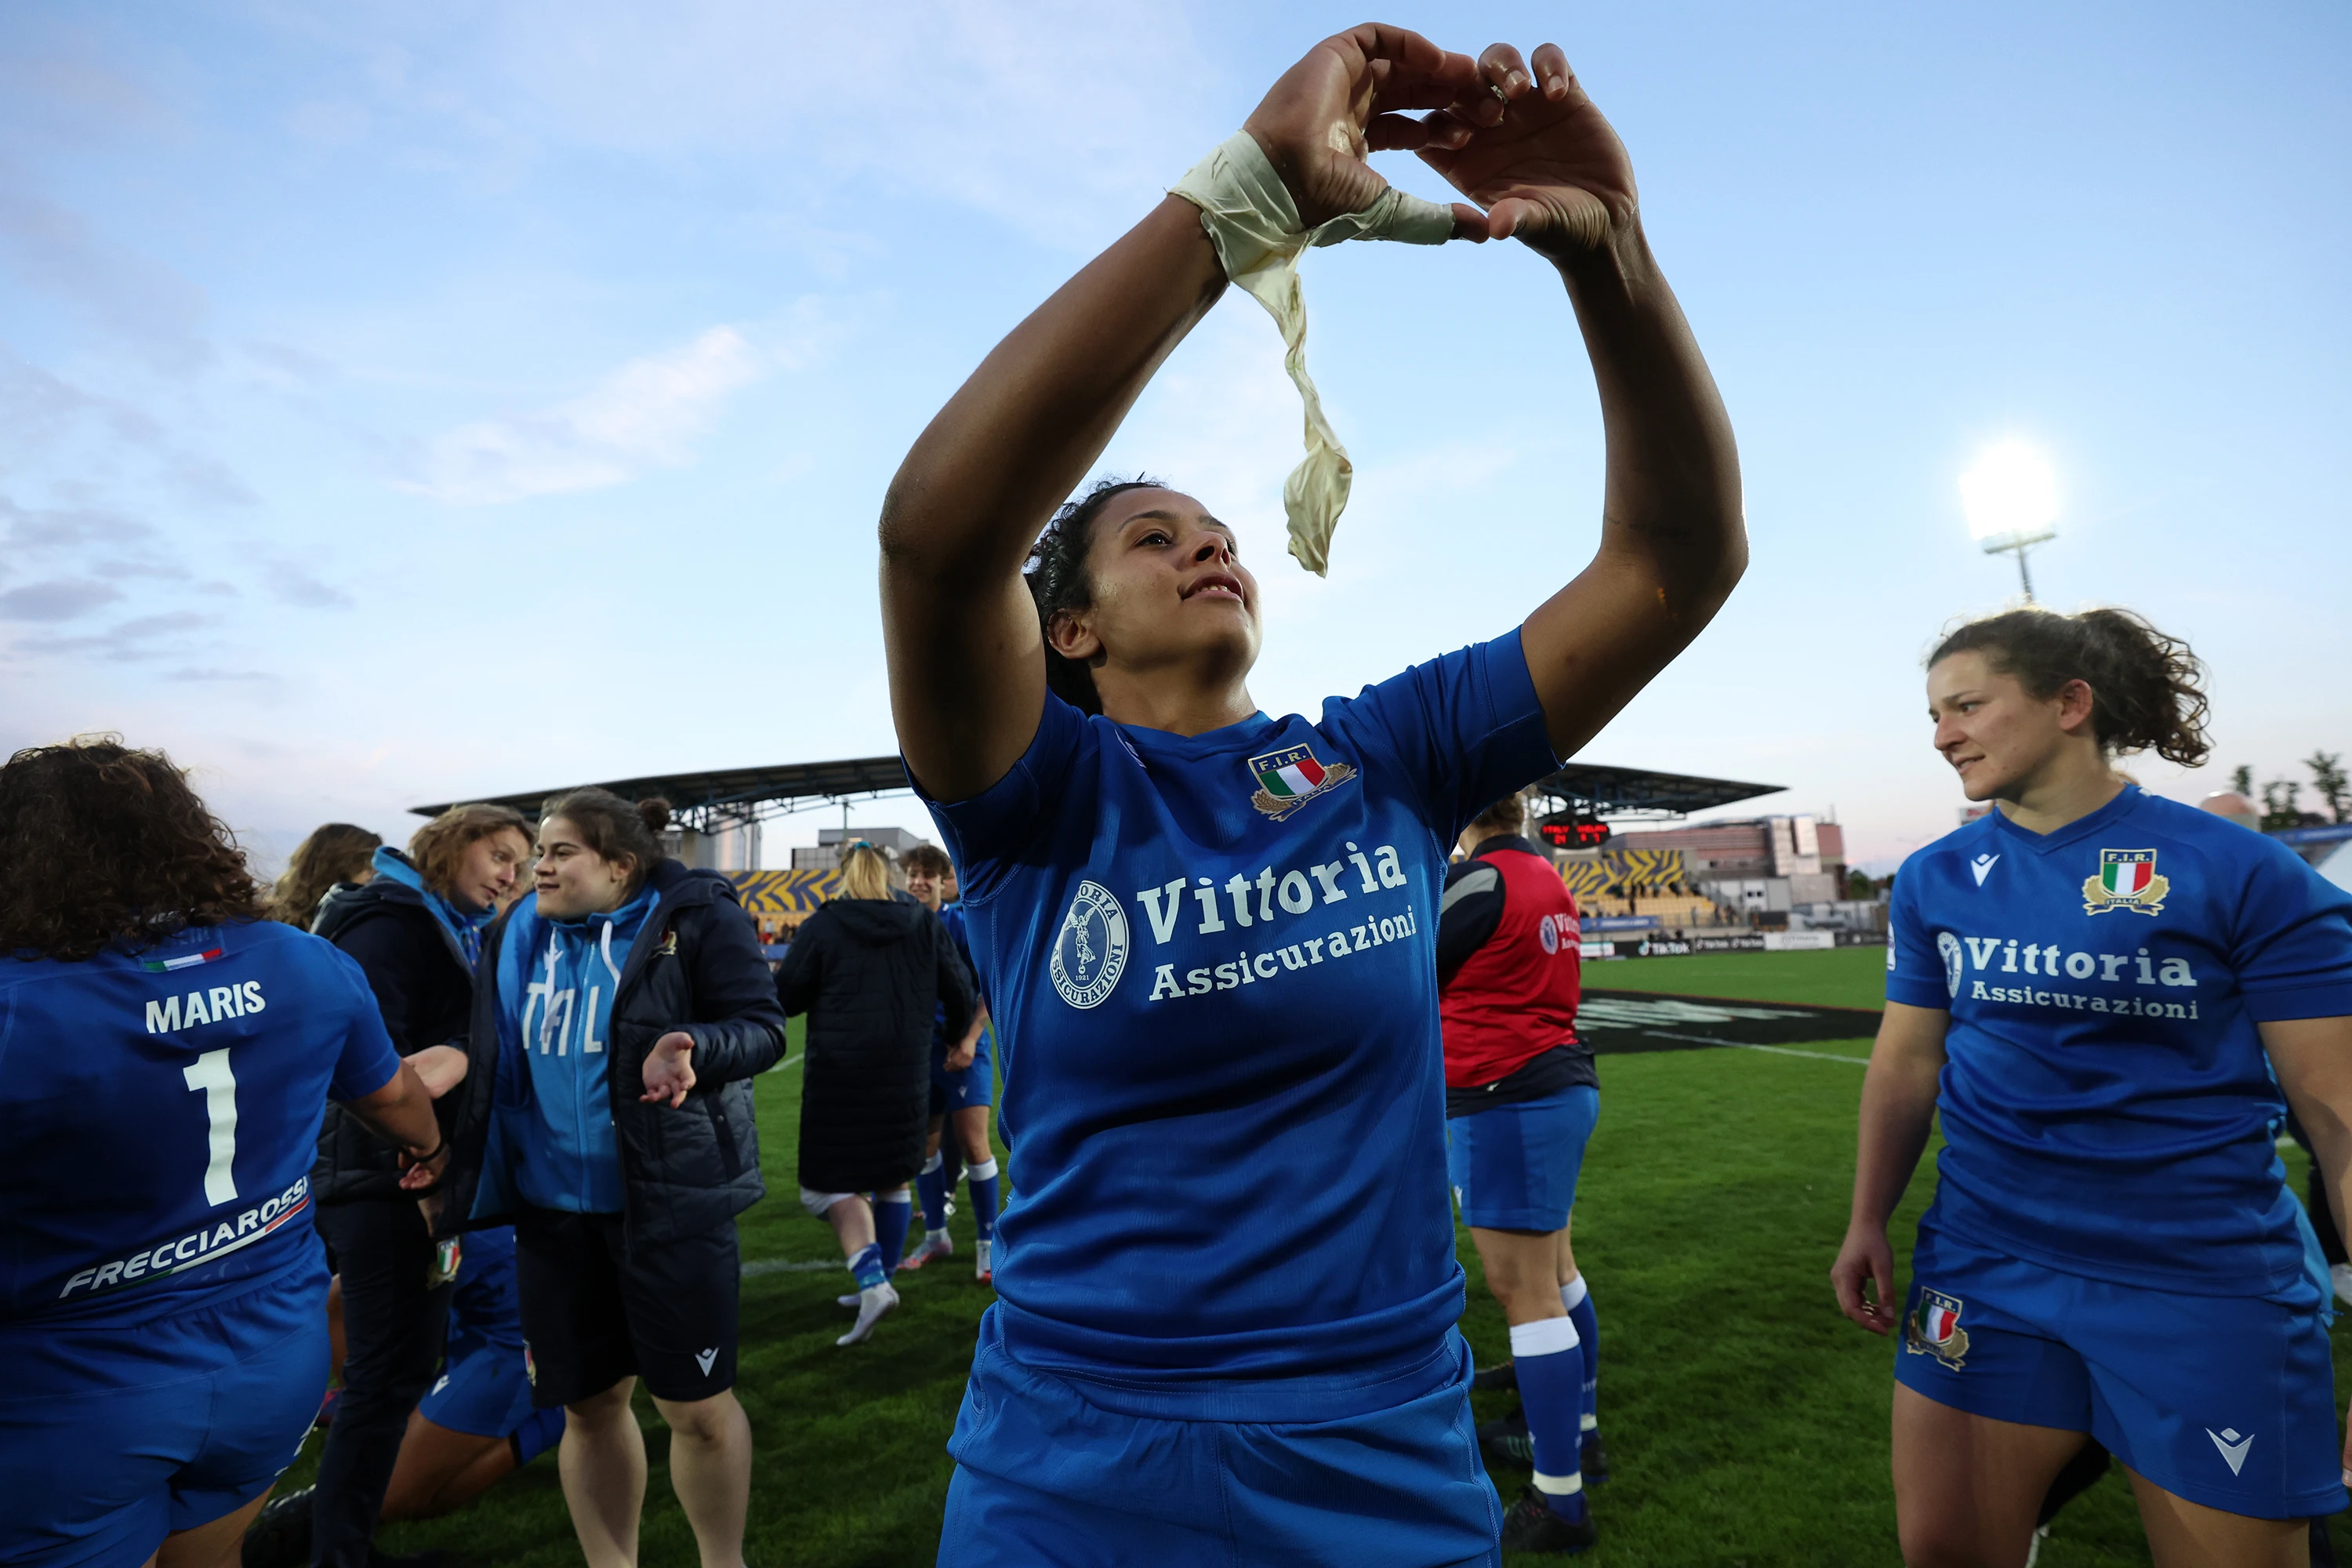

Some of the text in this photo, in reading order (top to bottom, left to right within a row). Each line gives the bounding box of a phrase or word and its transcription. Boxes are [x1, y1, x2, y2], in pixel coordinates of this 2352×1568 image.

[1258, 752, 1307, 771] F.I.R.
[1293, 784, 1331, 806] ITALIA
[2107, 853, 2151, 862] F.I.R.
[1137, 841, 1408, 945] Vittoria
[1149, 905, 1417, 1001] Assicurazioni
[1652, 942, 1690, 955] TikTok
[1964, 937, 2198, 987] Vittoria
[146, 980, 266, 1034] MARIS
[1971, 981, 2199, 1020] Assicurazioni
[183, 1047, 238, 1207] 1
